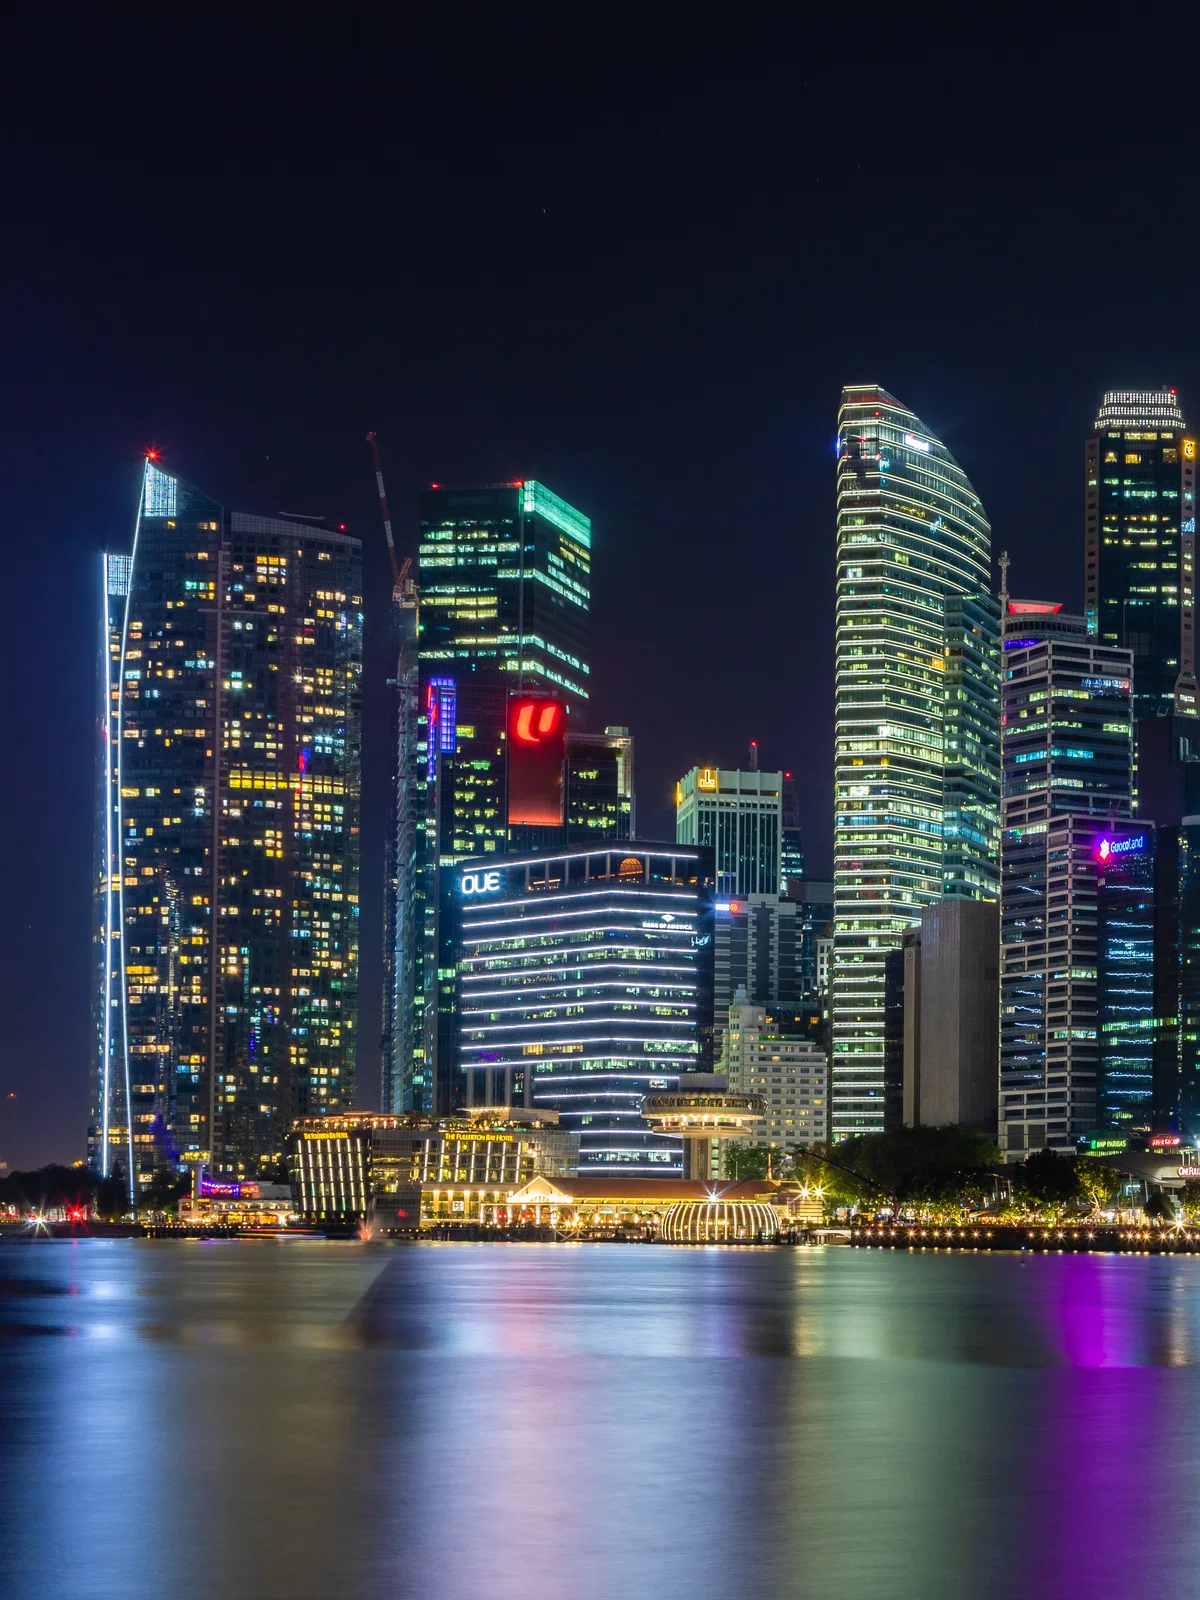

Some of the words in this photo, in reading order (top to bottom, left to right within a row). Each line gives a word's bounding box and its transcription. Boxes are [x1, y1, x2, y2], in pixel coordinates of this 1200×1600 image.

[1110, 836, 1143, 853] GuocoLand
[462, 872, 500, 894] OUE
[1107, 1140, 1127, 1148] PARIBAS
